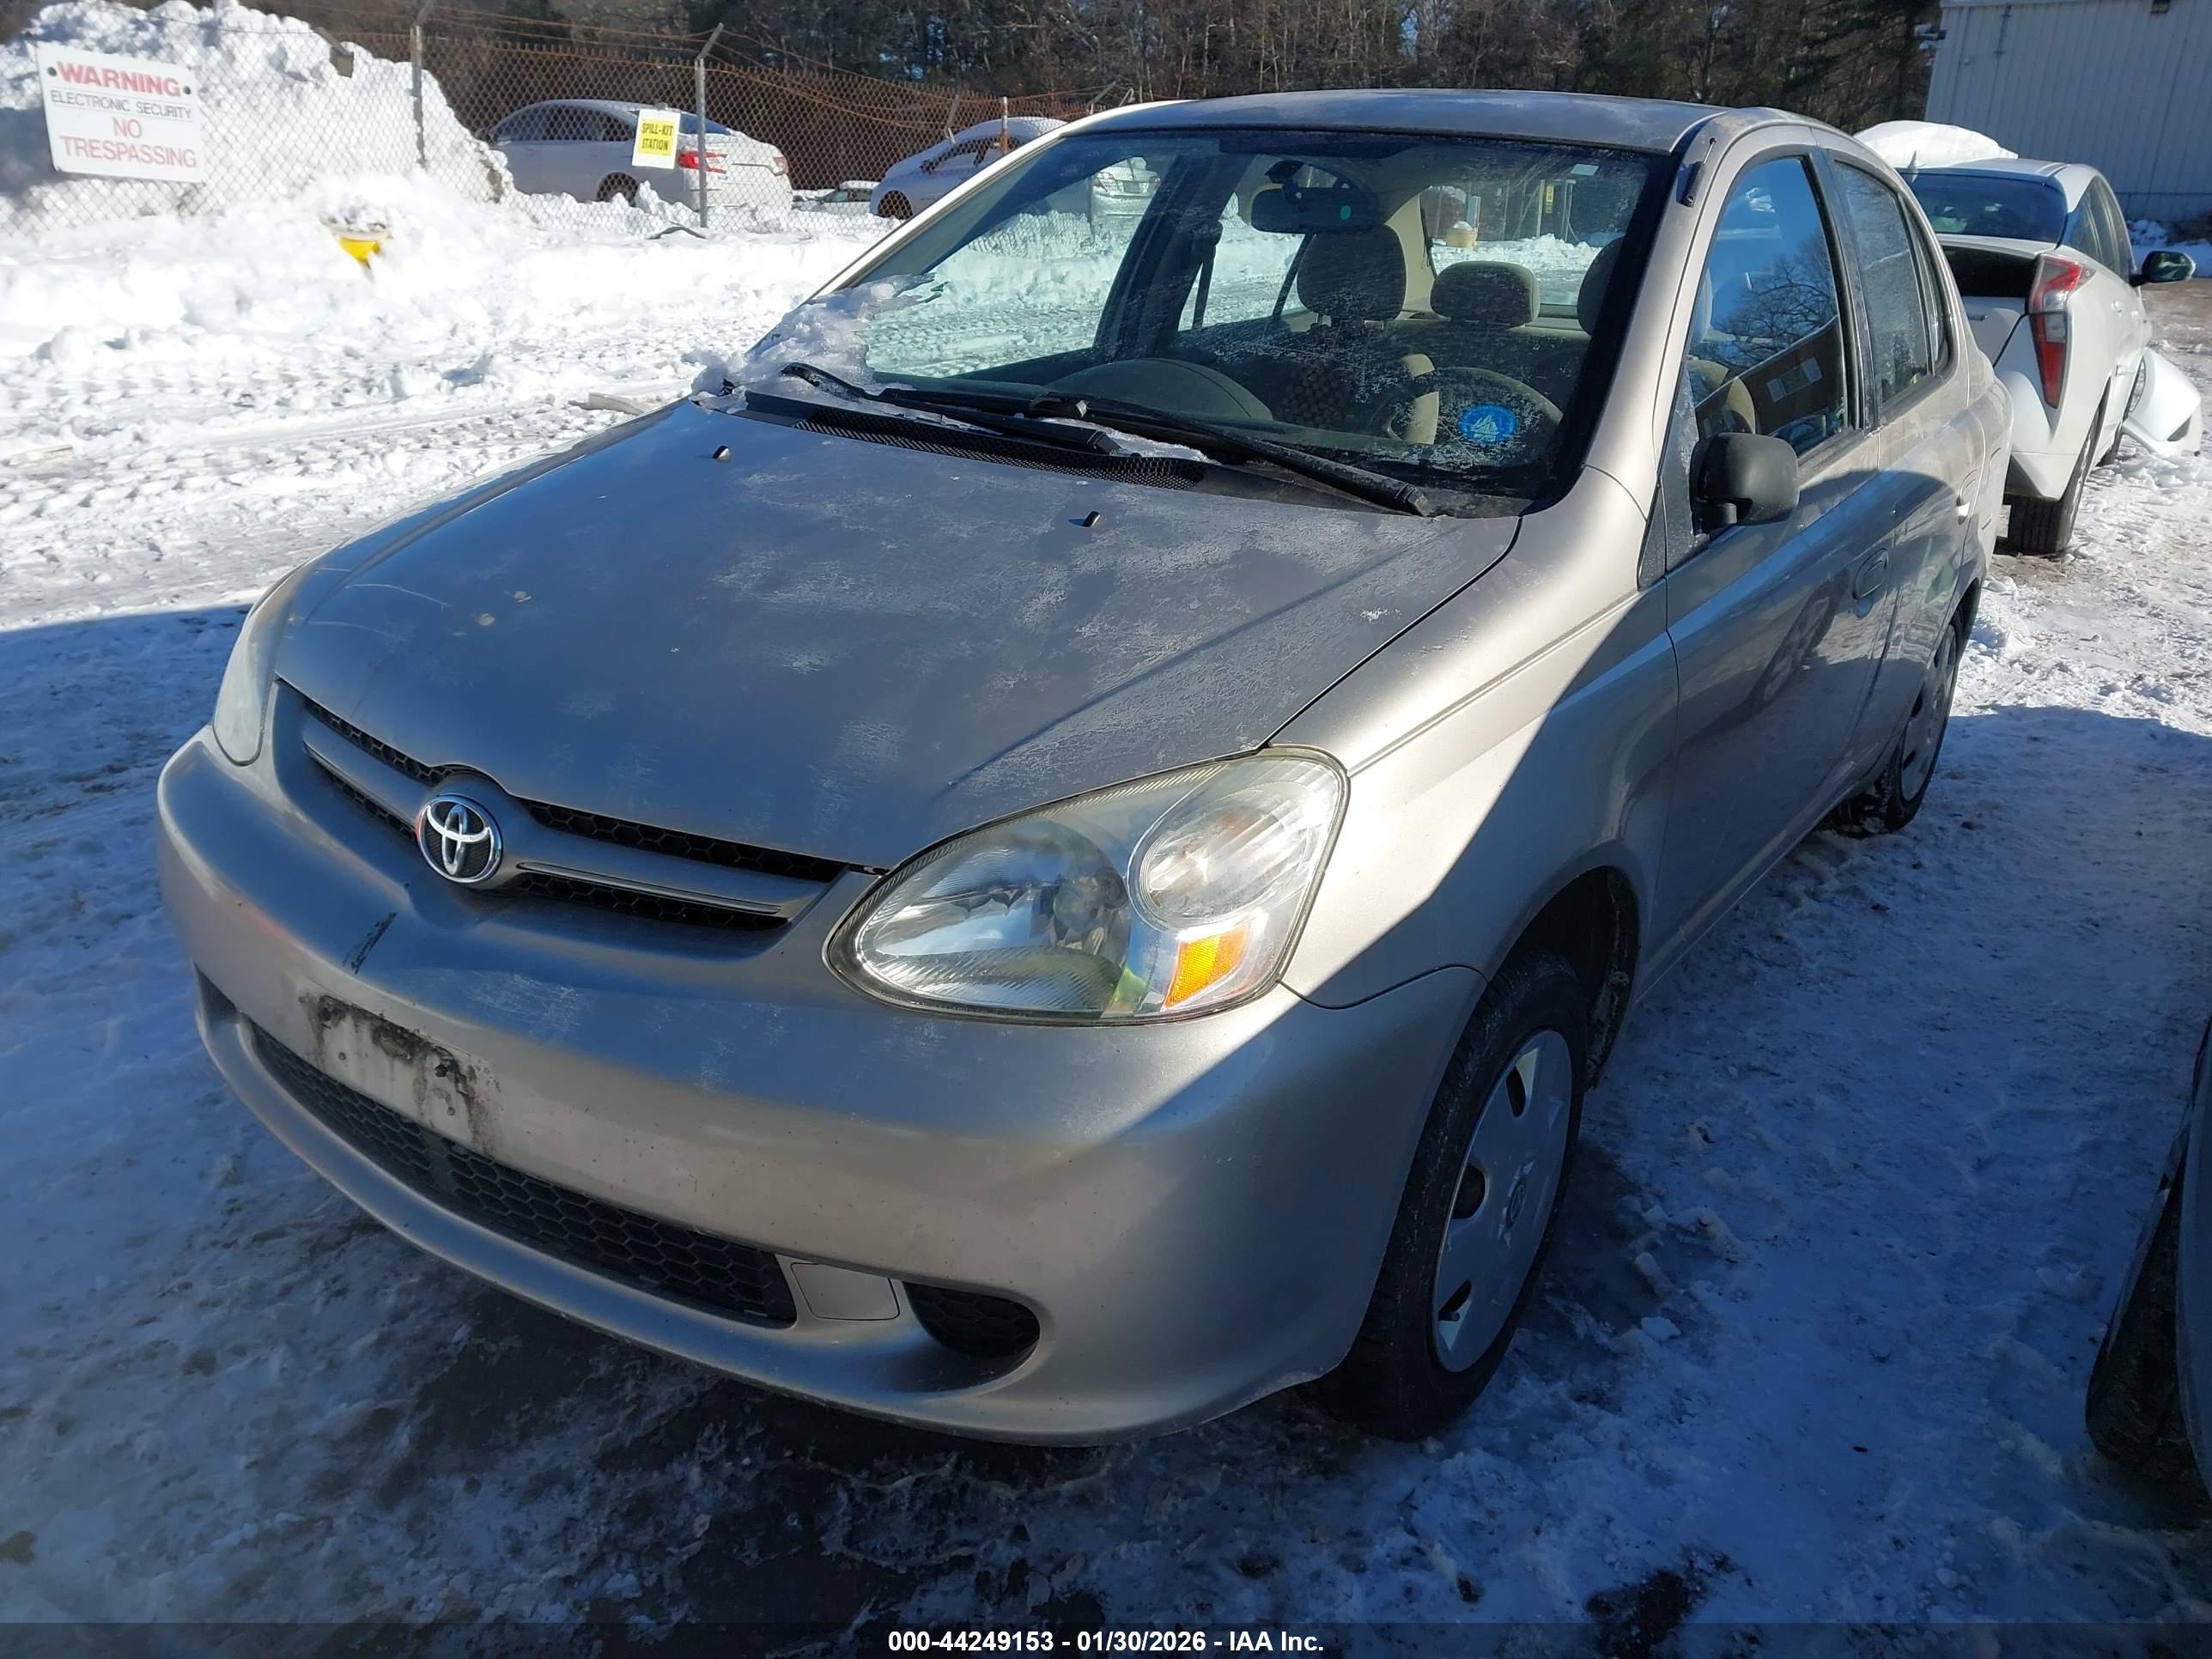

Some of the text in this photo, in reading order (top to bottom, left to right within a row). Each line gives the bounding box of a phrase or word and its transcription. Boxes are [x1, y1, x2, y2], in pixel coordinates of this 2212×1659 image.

[57, 61, 181, 97] WARNING
[51, 89, 192, 119] ELECTRONIC SECURITY
[112, 117, 143, 138] NO
[641, 122, 674, 137] SPILL-KIT
[59, 136, 197, 167] TRESPASSING
[641, 138, 669, 151] STATION
